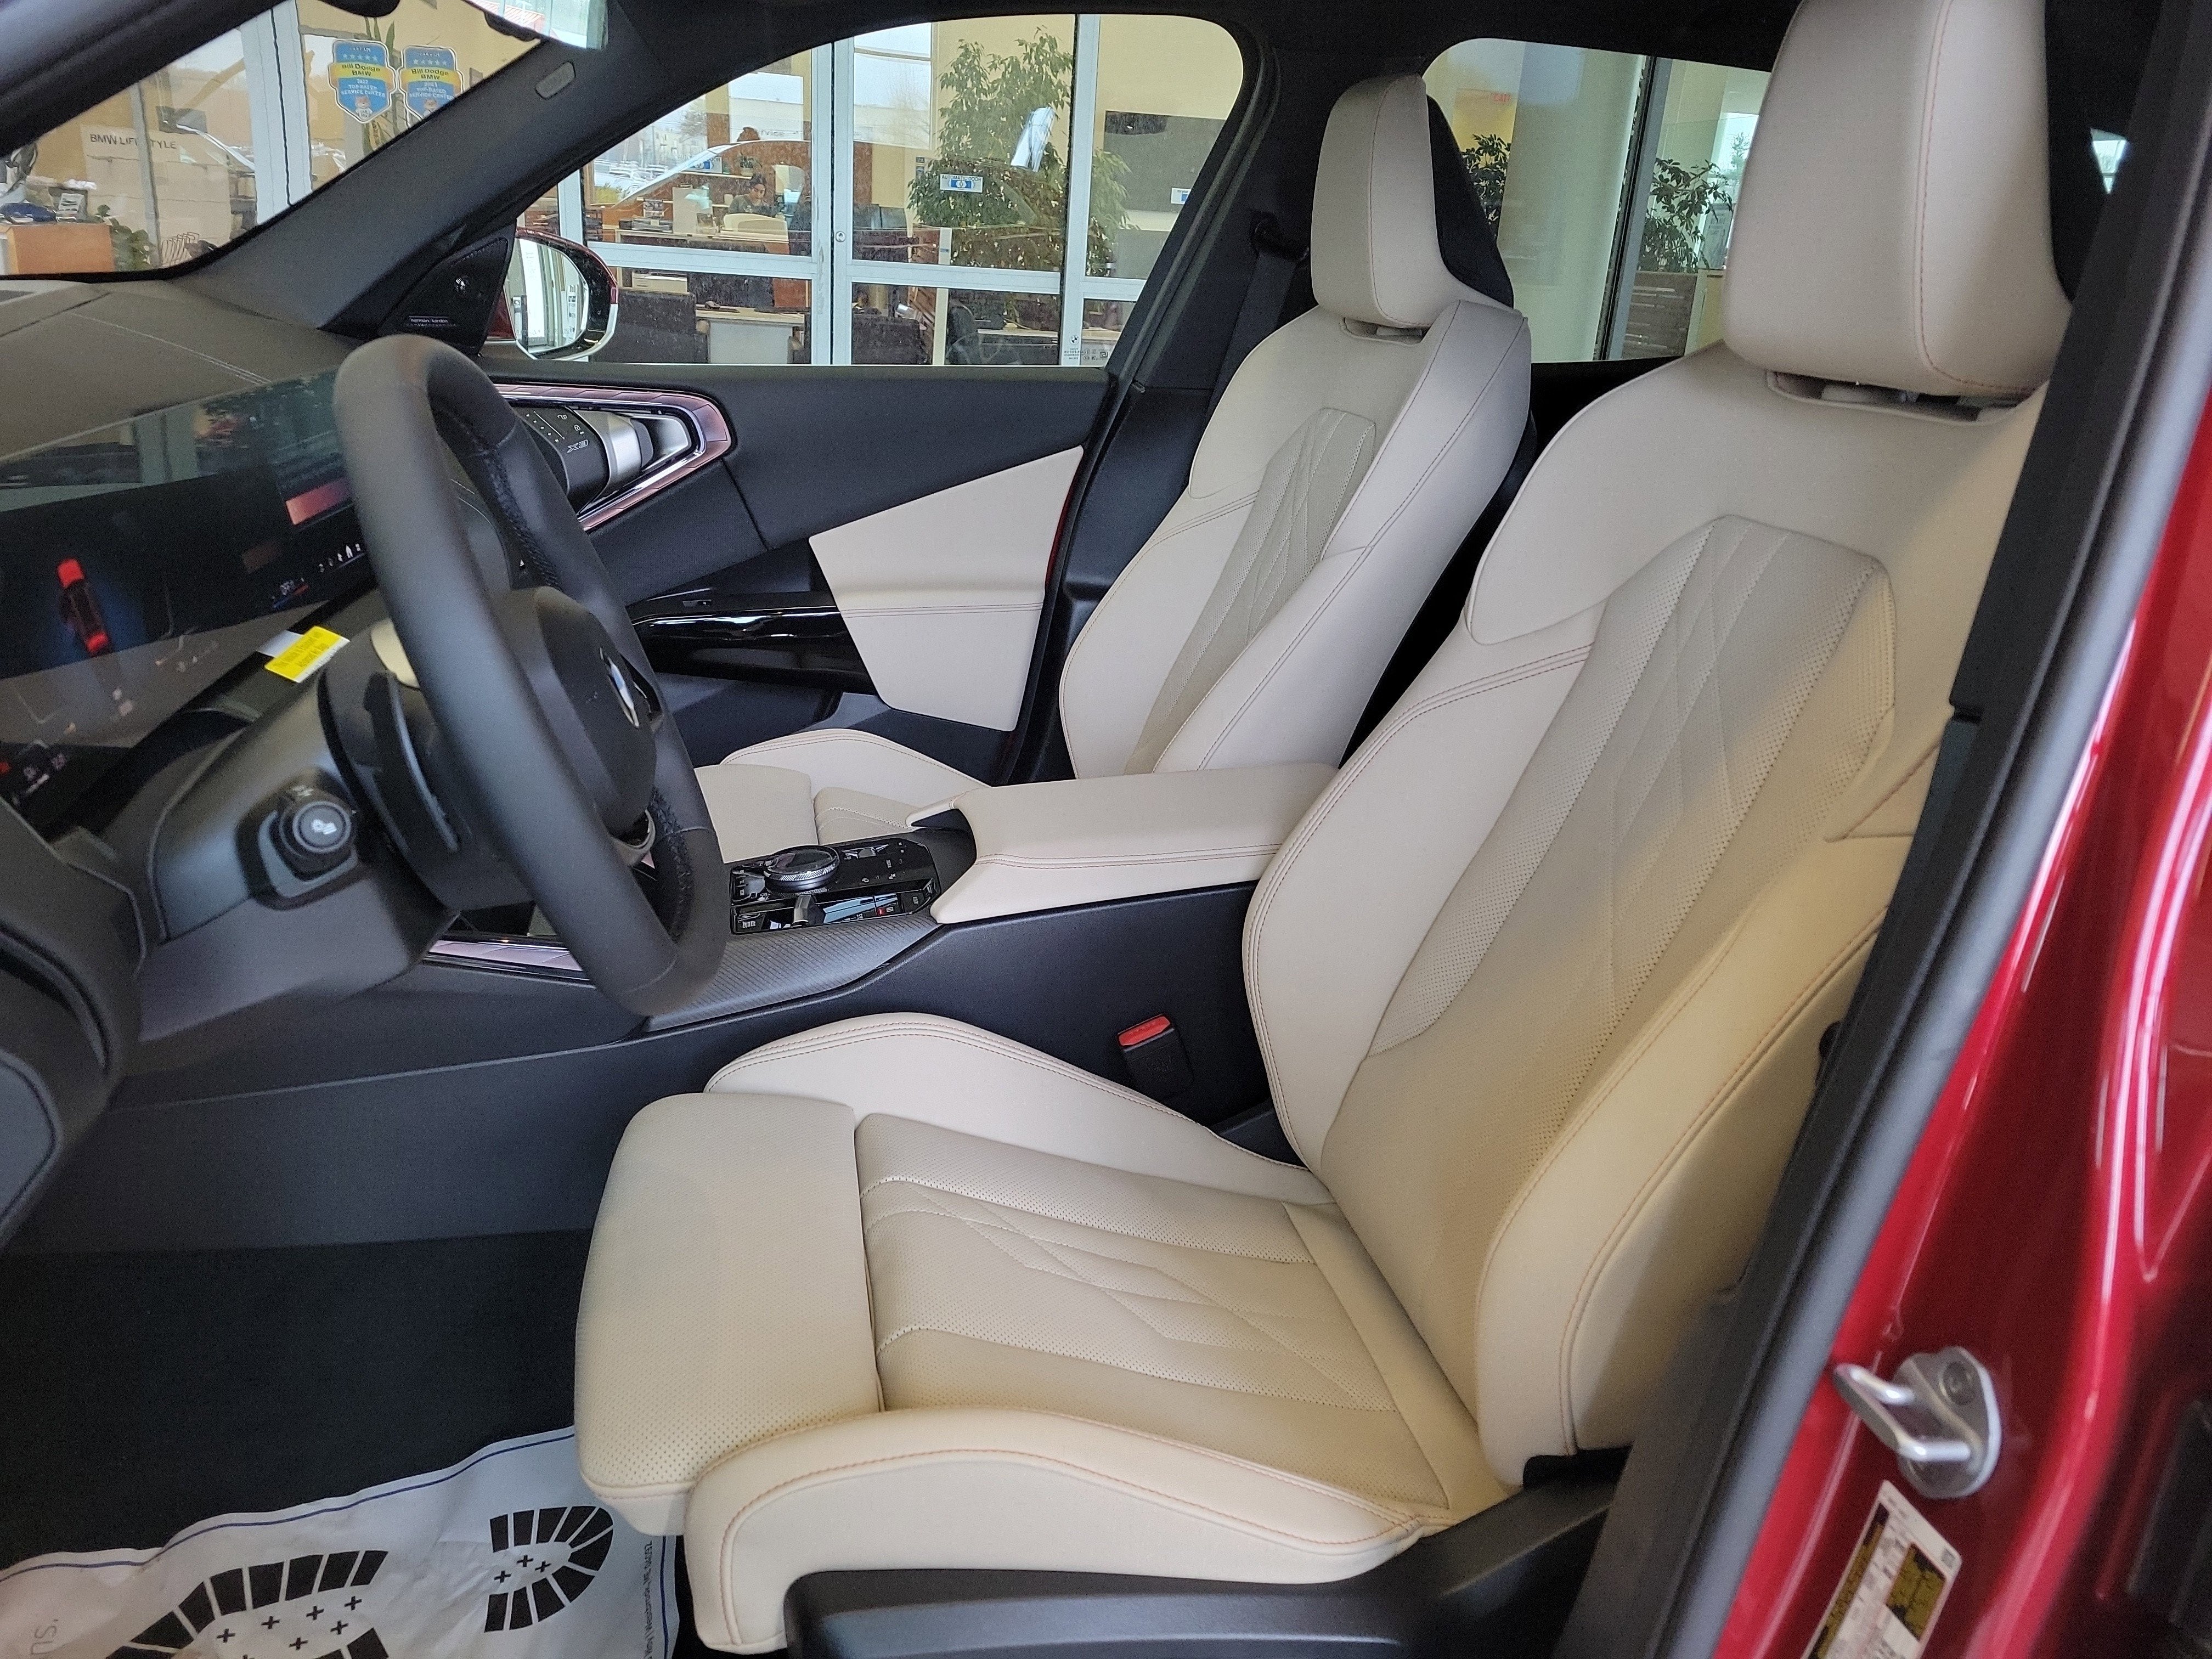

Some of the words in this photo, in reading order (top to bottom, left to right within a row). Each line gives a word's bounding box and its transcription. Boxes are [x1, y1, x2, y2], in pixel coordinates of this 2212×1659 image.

[355, 64, 380, 72] Dodge
[90, 134, 117, 145] BMW
[120, 137, 177, 149] LIFTYLE
